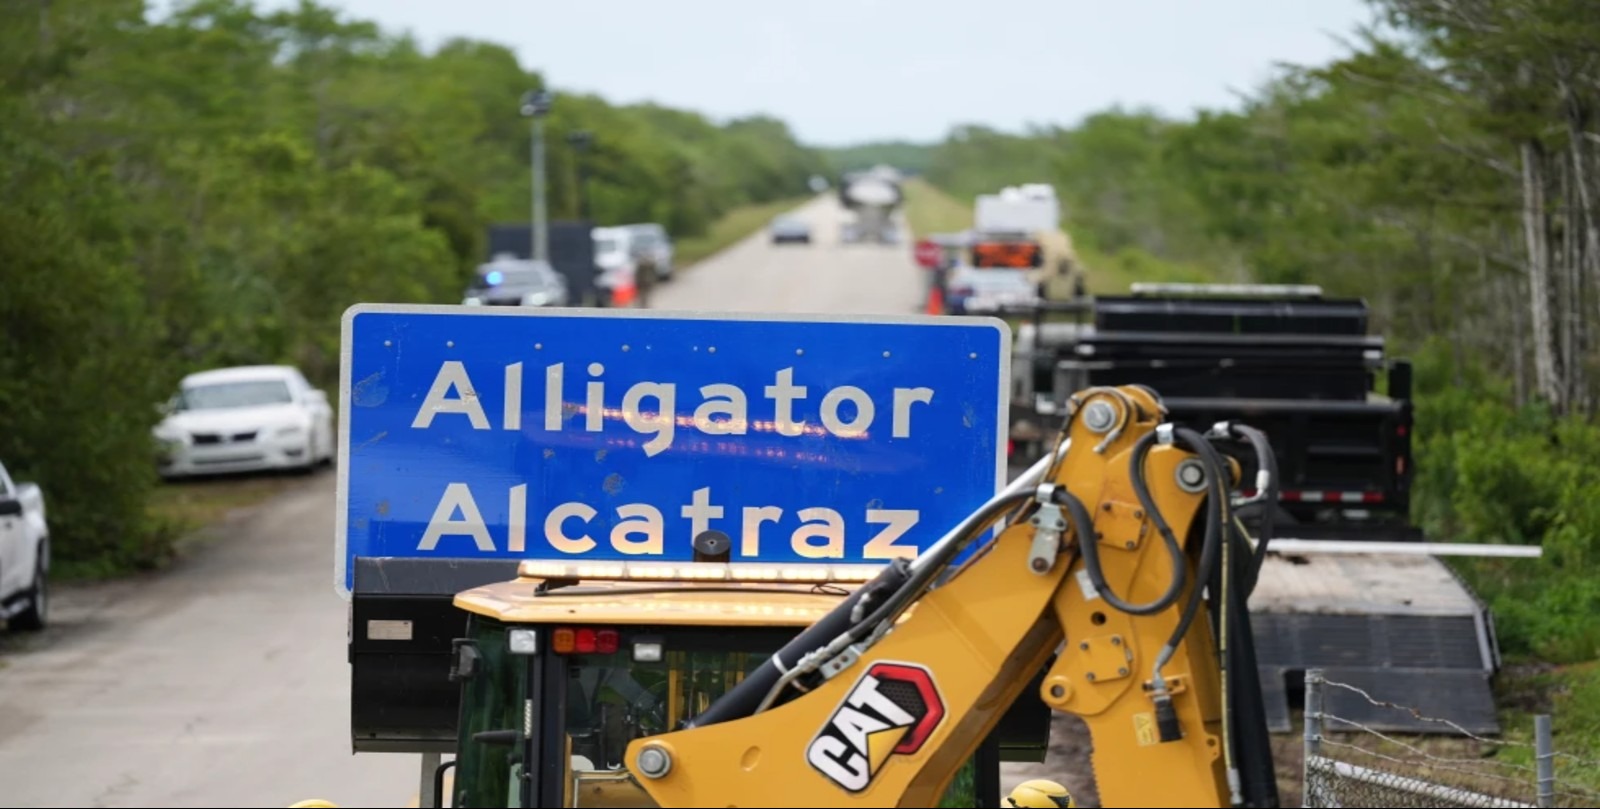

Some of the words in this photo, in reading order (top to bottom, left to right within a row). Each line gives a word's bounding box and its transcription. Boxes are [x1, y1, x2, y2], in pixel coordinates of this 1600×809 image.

[411, 360, 934, 458] Alligator
[416, 482, 919, 559] Alcatraz
[808, 674, 916, 791] CAT
